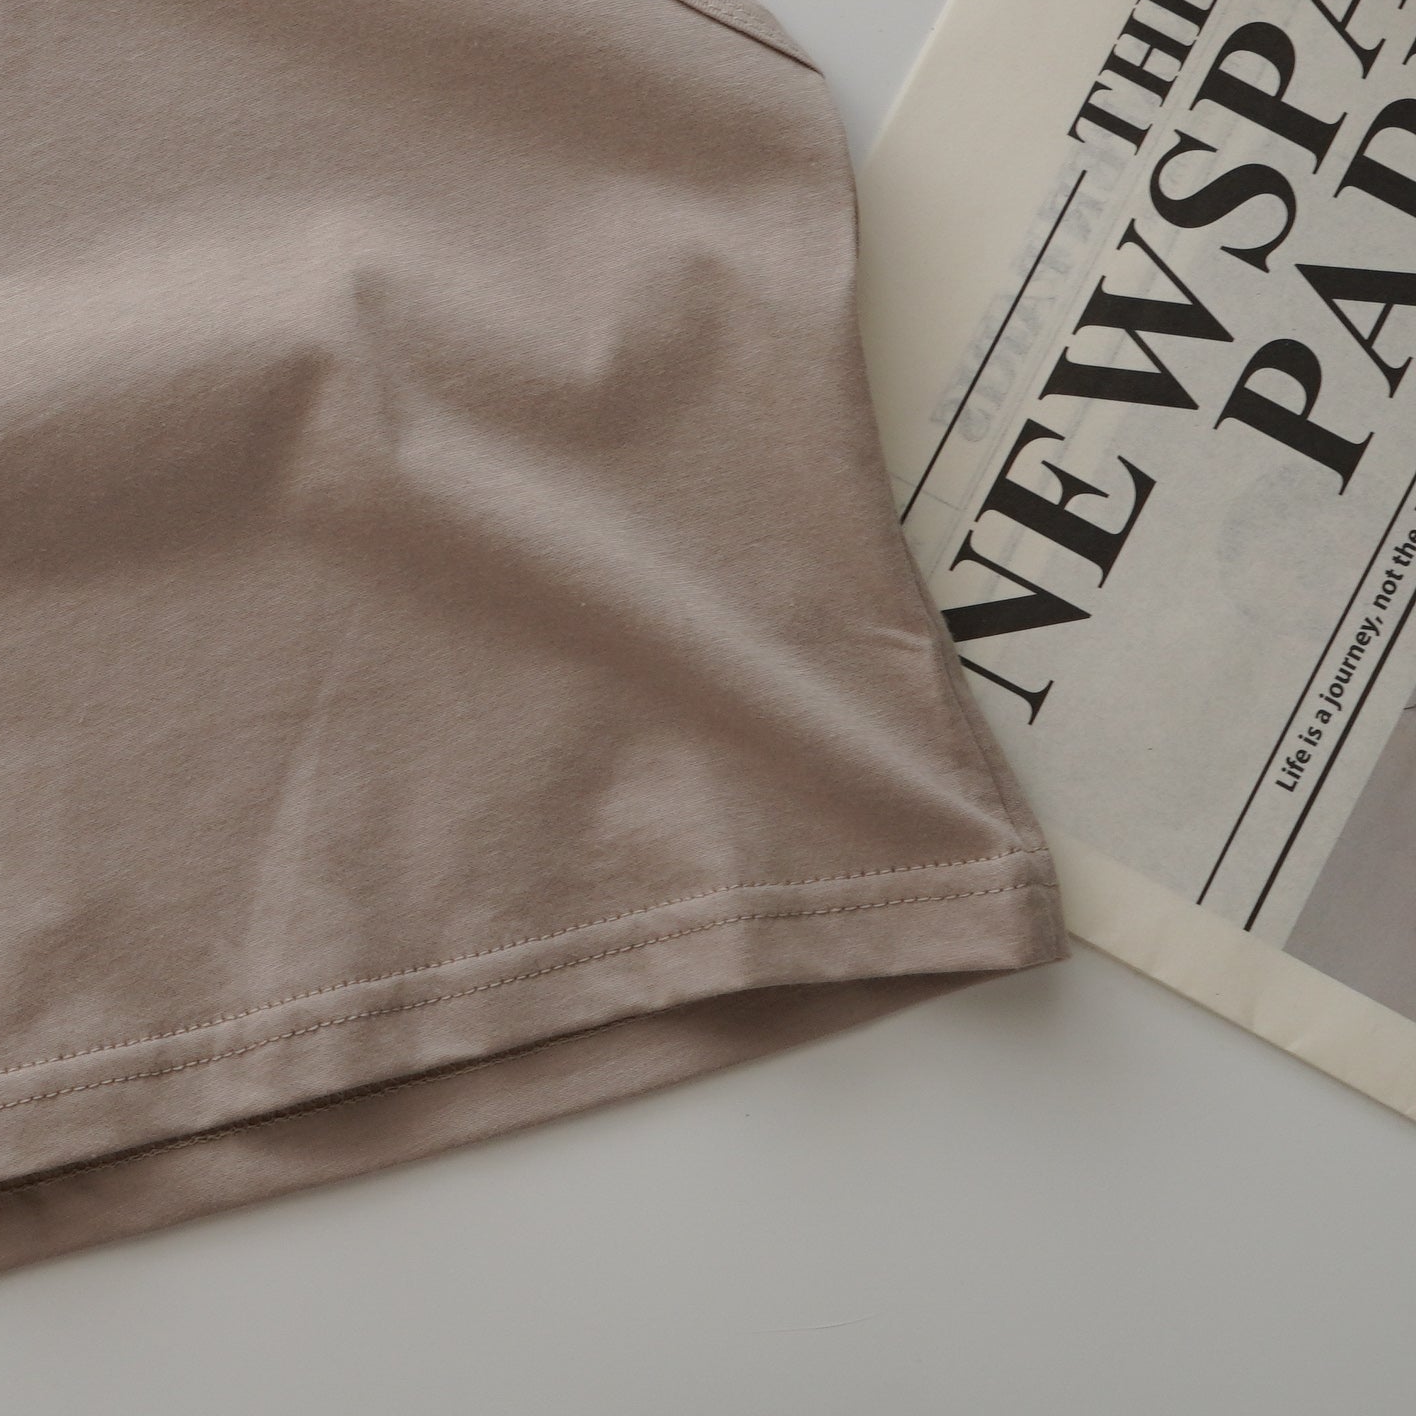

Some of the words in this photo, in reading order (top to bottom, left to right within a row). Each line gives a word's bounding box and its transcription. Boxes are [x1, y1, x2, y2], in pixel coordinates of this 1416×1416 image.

[1214, 38, 1416, 496] PA
[1372, 568, 1405, 611] not
[1318, 616, 1385, 712] journey,
[1297, 726, 1323, 747] is
[1315, 709, 1333, 725] a
[1275, 749, 1312, 793] Life
